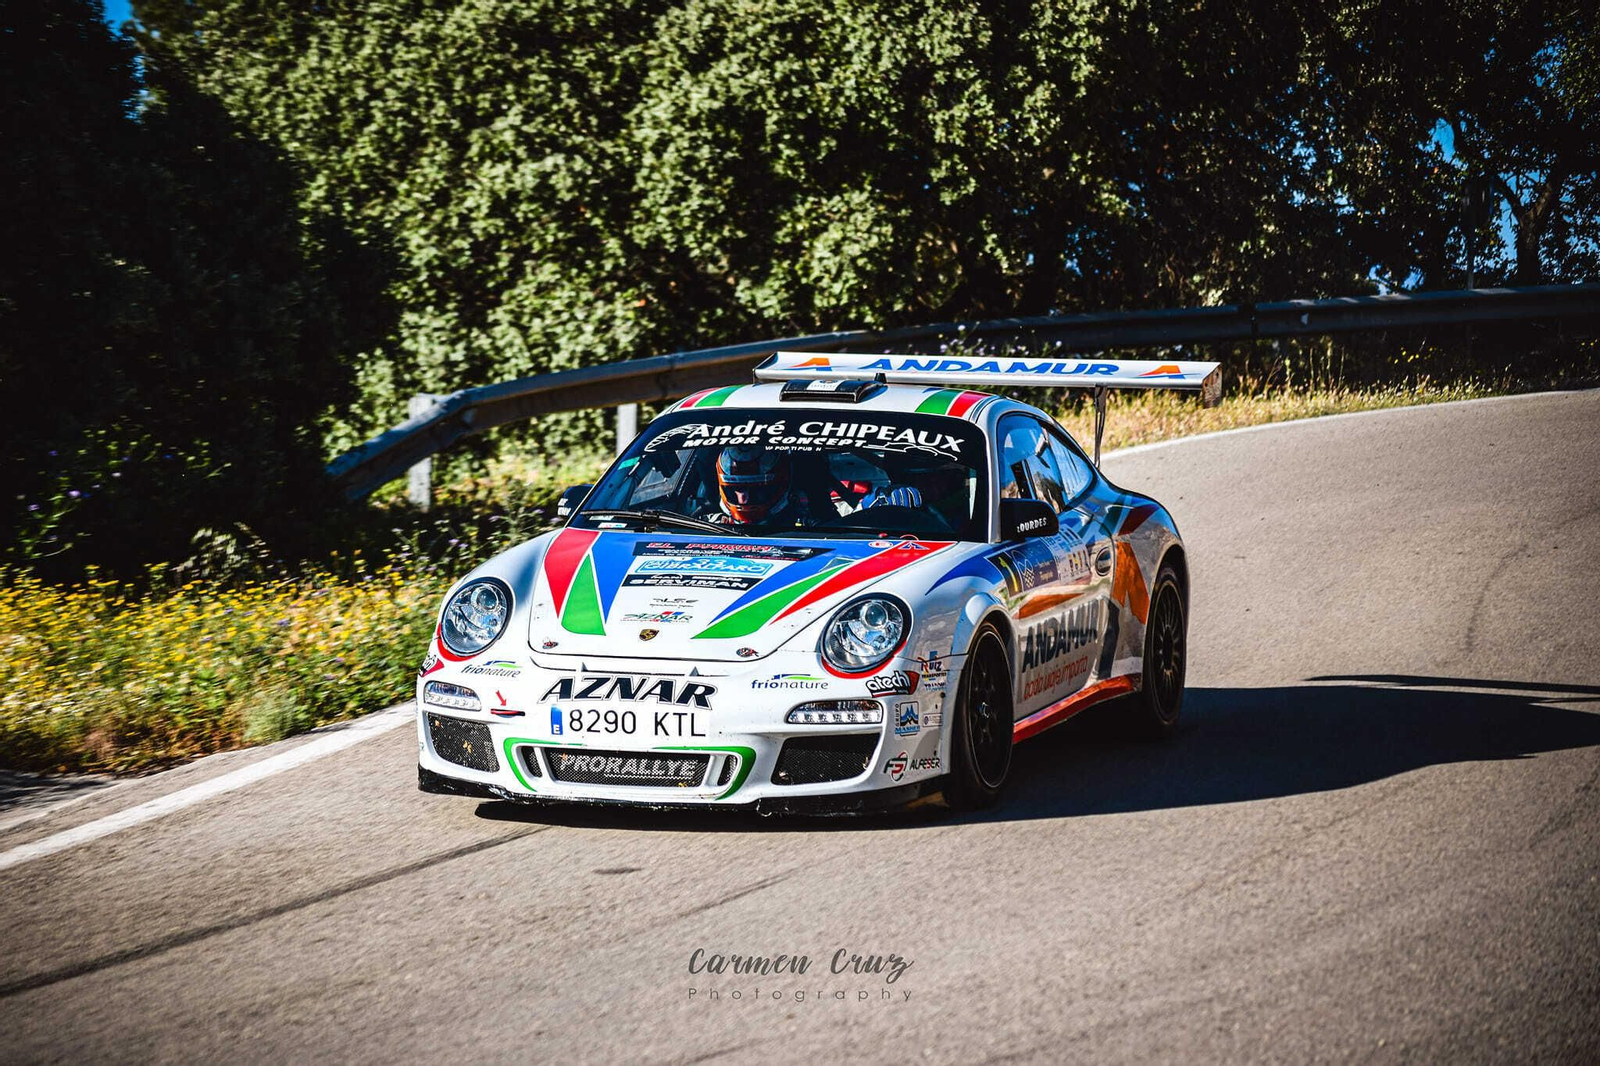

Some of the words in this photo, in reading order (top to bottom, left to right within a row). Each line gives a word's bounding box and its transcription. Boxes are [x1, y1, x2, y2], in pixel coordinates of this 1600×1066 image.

[857, 358, 1120, 376] ANDAMUR
[683, 435, 757, 448] MOTOR
[768, 436, 868, 449] CONCEPT
[687, 420, 786, 438] André
[799, 421, 965, 453] CHIPEAUX
[866, 671, 908, 691] atech
[537, 675, 718, 710] AZNAR
[553, 725, 560, 734] E
[569, 709, 637, 735] 8290
[654, 712, 707, 737] KTL
[559, 755, 699, 776] PRORALLYE
